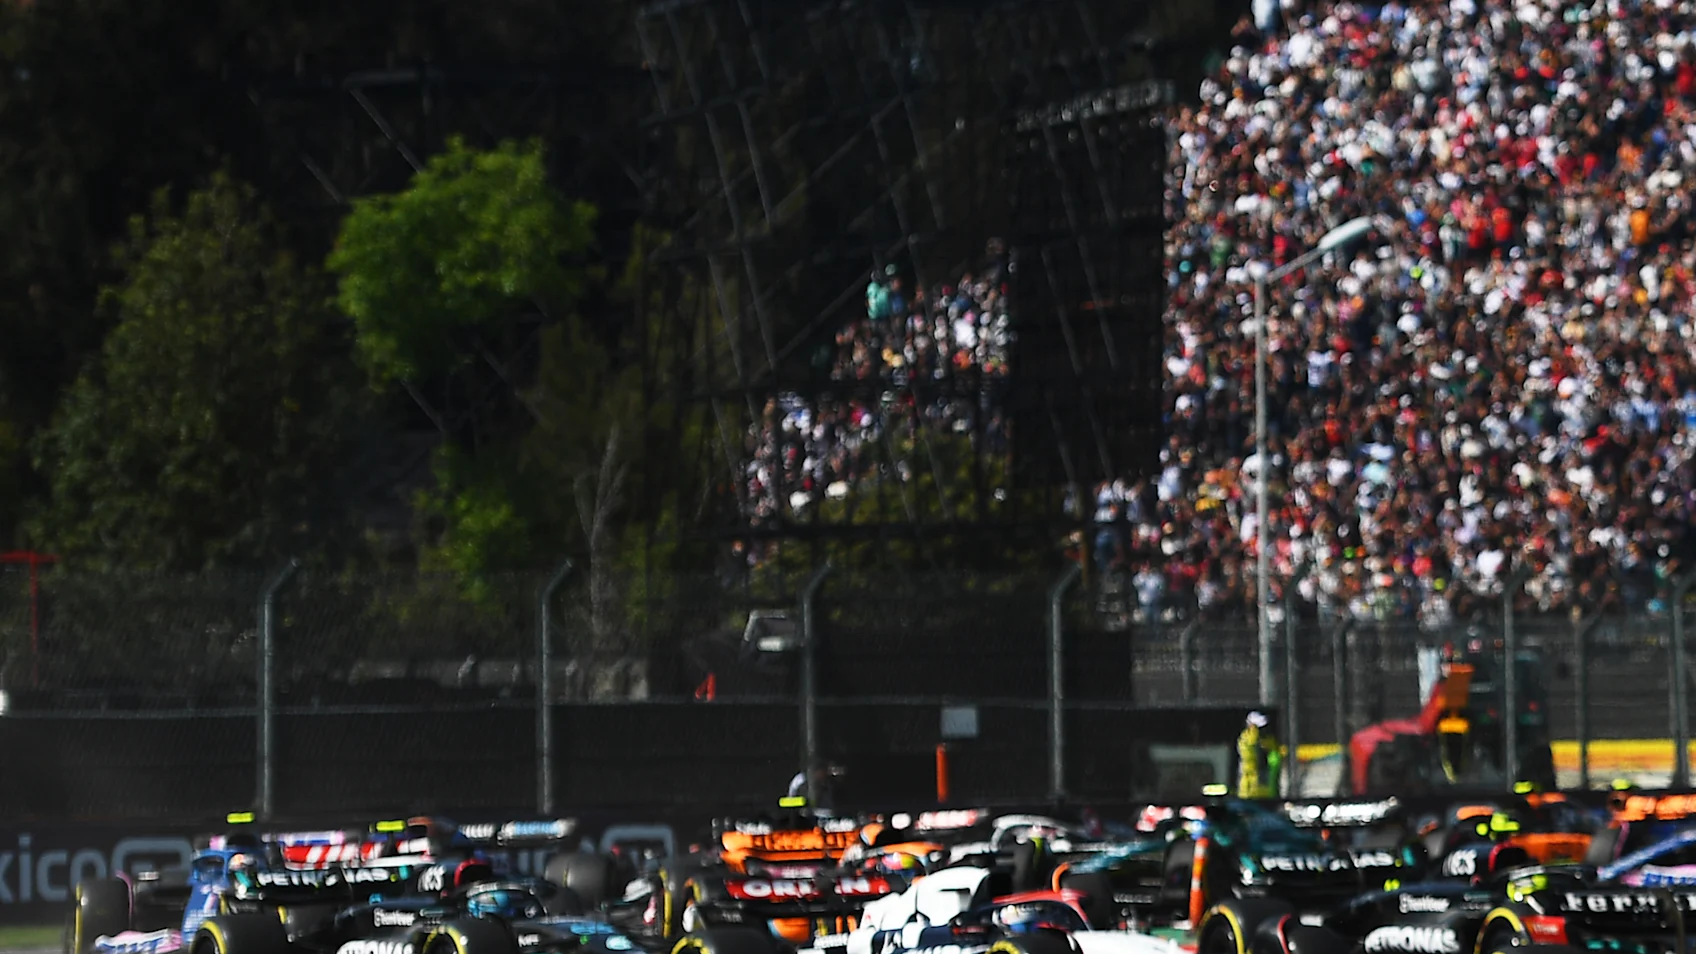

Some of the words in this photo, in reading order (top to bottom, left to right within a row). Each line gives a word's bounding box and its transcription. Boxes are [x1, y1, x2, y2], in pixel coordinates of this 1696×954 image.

[1260, 853, 1395, 873] PETRNAS
[256, 866, 390, 889] PETRNAS
[1364, 925, 1460, 954] PETRONAS
